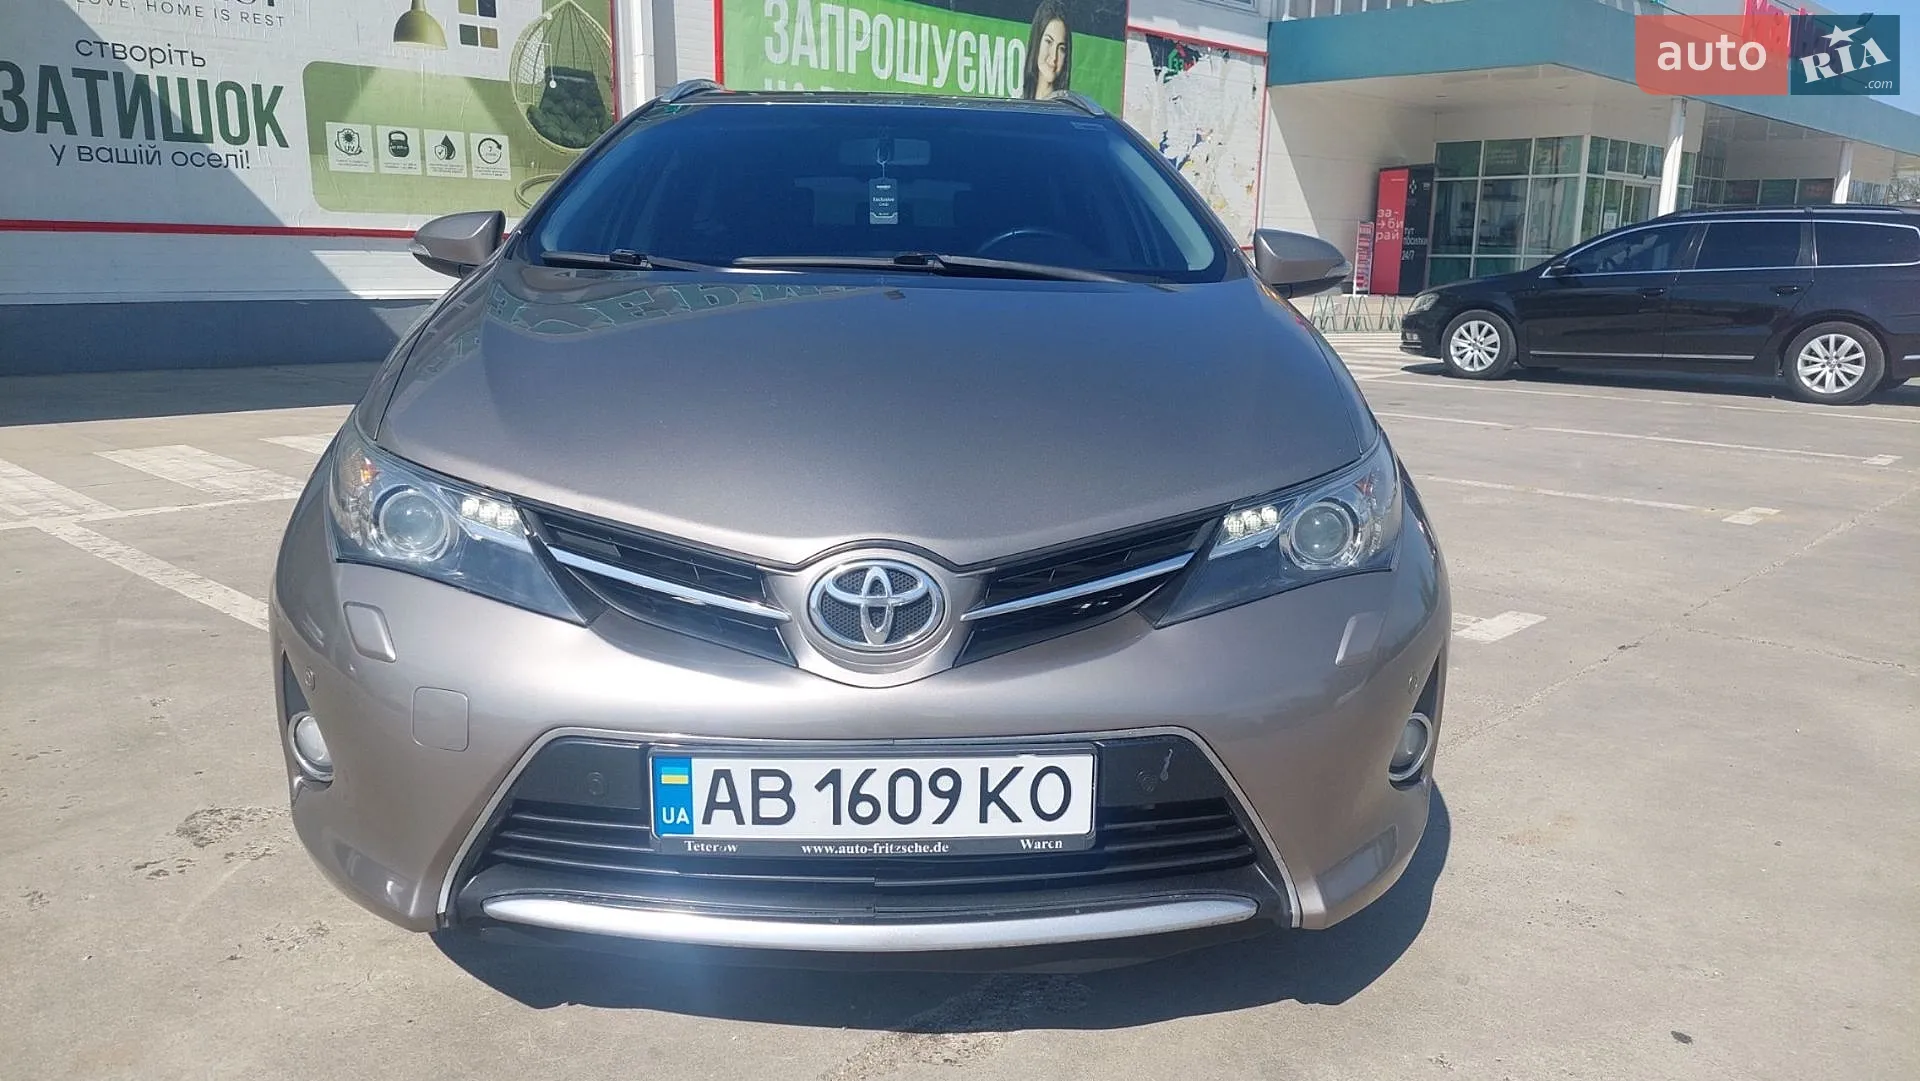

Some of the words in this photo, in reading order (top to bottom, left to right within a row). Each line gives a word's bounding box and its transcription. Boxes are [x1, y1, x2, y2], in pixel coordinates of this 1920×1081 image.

[146, 0, 203, 18] HOME
[213, 8, 231, 21] IS
[240, 11, 285, 27] REST
[75, 39, 206, 69] створіть
[764, 0, 1026, 99] ЗАПРОШУЄМО
[0, 60, 290, 148] ЗАТИШОК
[50, 144, 67, 166] у
[78, 143, 162, 166] вашій
[171, 148, 251, 169] оселі!
[1375, 228, 1400, 242] рай
[702, 768, 796, 826] AB
[814, 767, 963, 826] 1609
[979, 765, 1072, 824] KO
[662, 806, 690, 824] UA
[801, 842, 949, 854] www.auto-fritzsche.de
